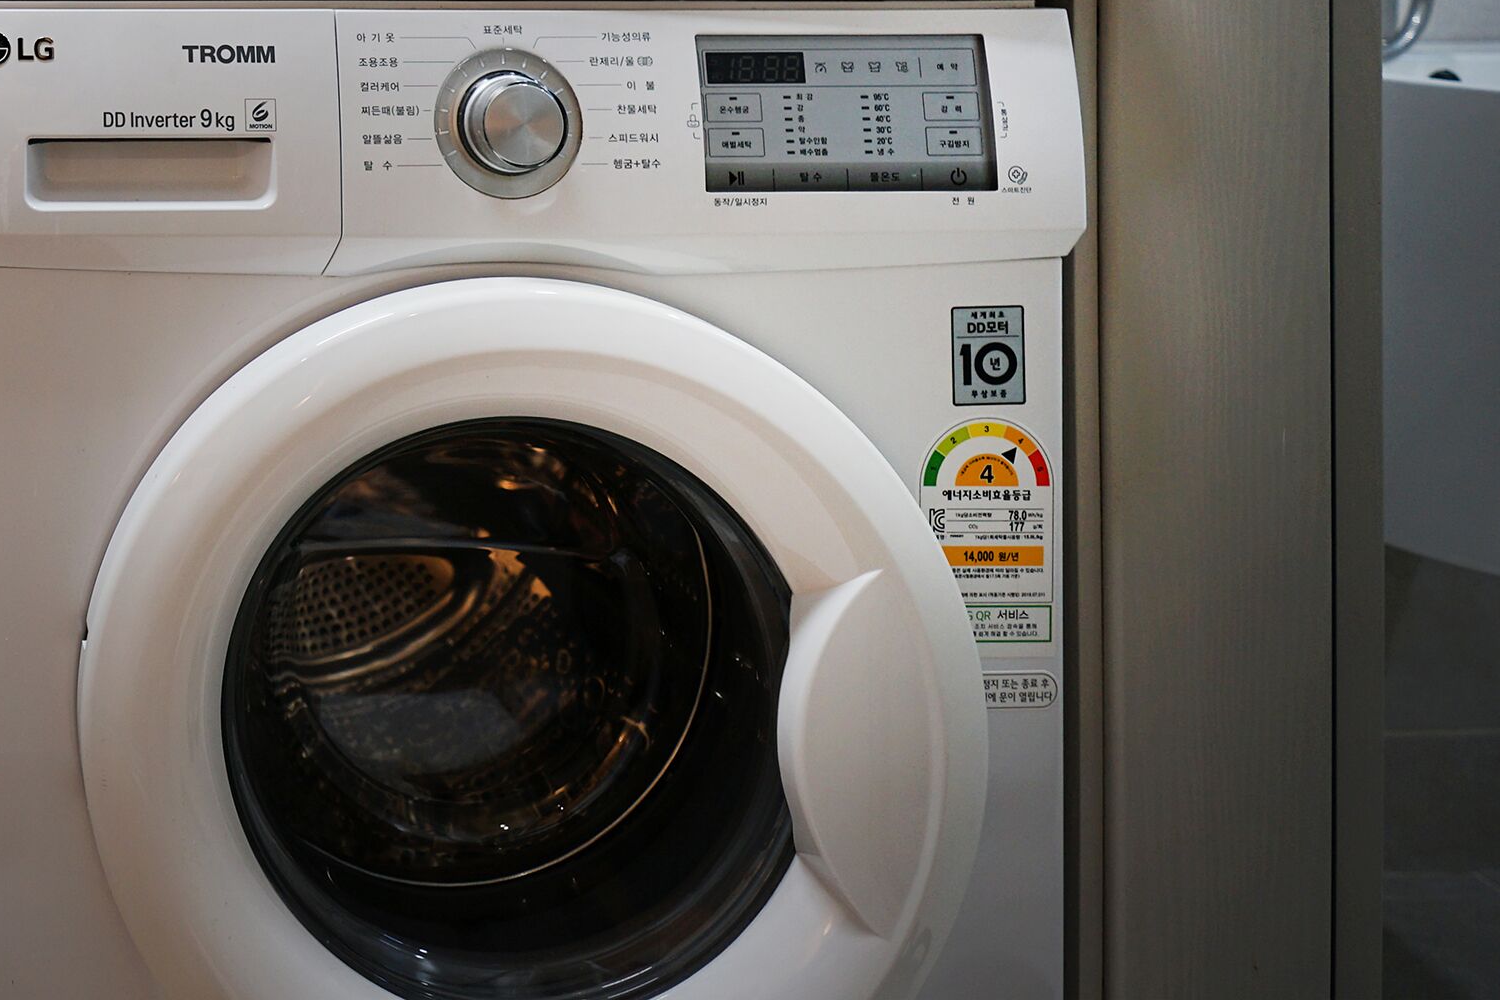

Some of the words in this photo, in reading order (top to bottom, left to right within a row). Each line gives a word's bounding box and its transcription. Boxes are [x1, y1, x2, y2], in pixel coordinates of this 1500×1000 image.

[483, 24, 523, 36] 표준세탁
[600, 31, 652, 44] 기능성의류
[16, 36, 55, 62] LG
[182, 44, 276, 64] TROMM
[358, 56, 399, 68] 조용조용
[588, 56, 635, 68] 란제리/울
[360, 80, 400, 93] 컬러케어
[360, 105, 420, 117] 찌든때(불림)
[616, 103, 657, 116] 찬물세탁
[719, 104, 750, 115] 온수헹굼
[796, 103, 805, 113] 강
[103, 111, 126, 129] DD
[130, 110, 197, 129] Inverter
[362, 133, 403, 145] 알뜰삶음
[607, 132, 660, 144] 스피드워시
[939, 138, 970, 149] 구김방지
[612, 158, 661, 171] 헹굼+탈수
[869, 171, 901, 183] 물온도
[713, 196, 768, 208] 동작/일시정지
[967, 321, 1009, 335] DD모터
[959, 342, 1018, 386] 10
[989, 357, 1001, 371] 년
[950, 437, 957, 445] 2
[984, 425, 990, 433] 3
[1017, 437, 1024, 445] 4
[980, 464, 994, 484] 4
[942, 490, 1032, 501] 에너지소비효율등급
[1008, 510, 1027, 521] 78.0
[1009, 521, 1025, 532] 177
[963, 550, 994, 563] 14,000
[998, 551, 1019, 562] 원/년
[975, 610, 991, 622] QR
[997, 609, 1029, 621] 서비스
[1001, 679, 1018, 690] 또는
[1021, 678, 1038, 690] 종료
[1041, 678, 1049, 689] 후
[999, 692, 1016, 703] 문이
[1018, 691, 1053, 703] 열립니다
